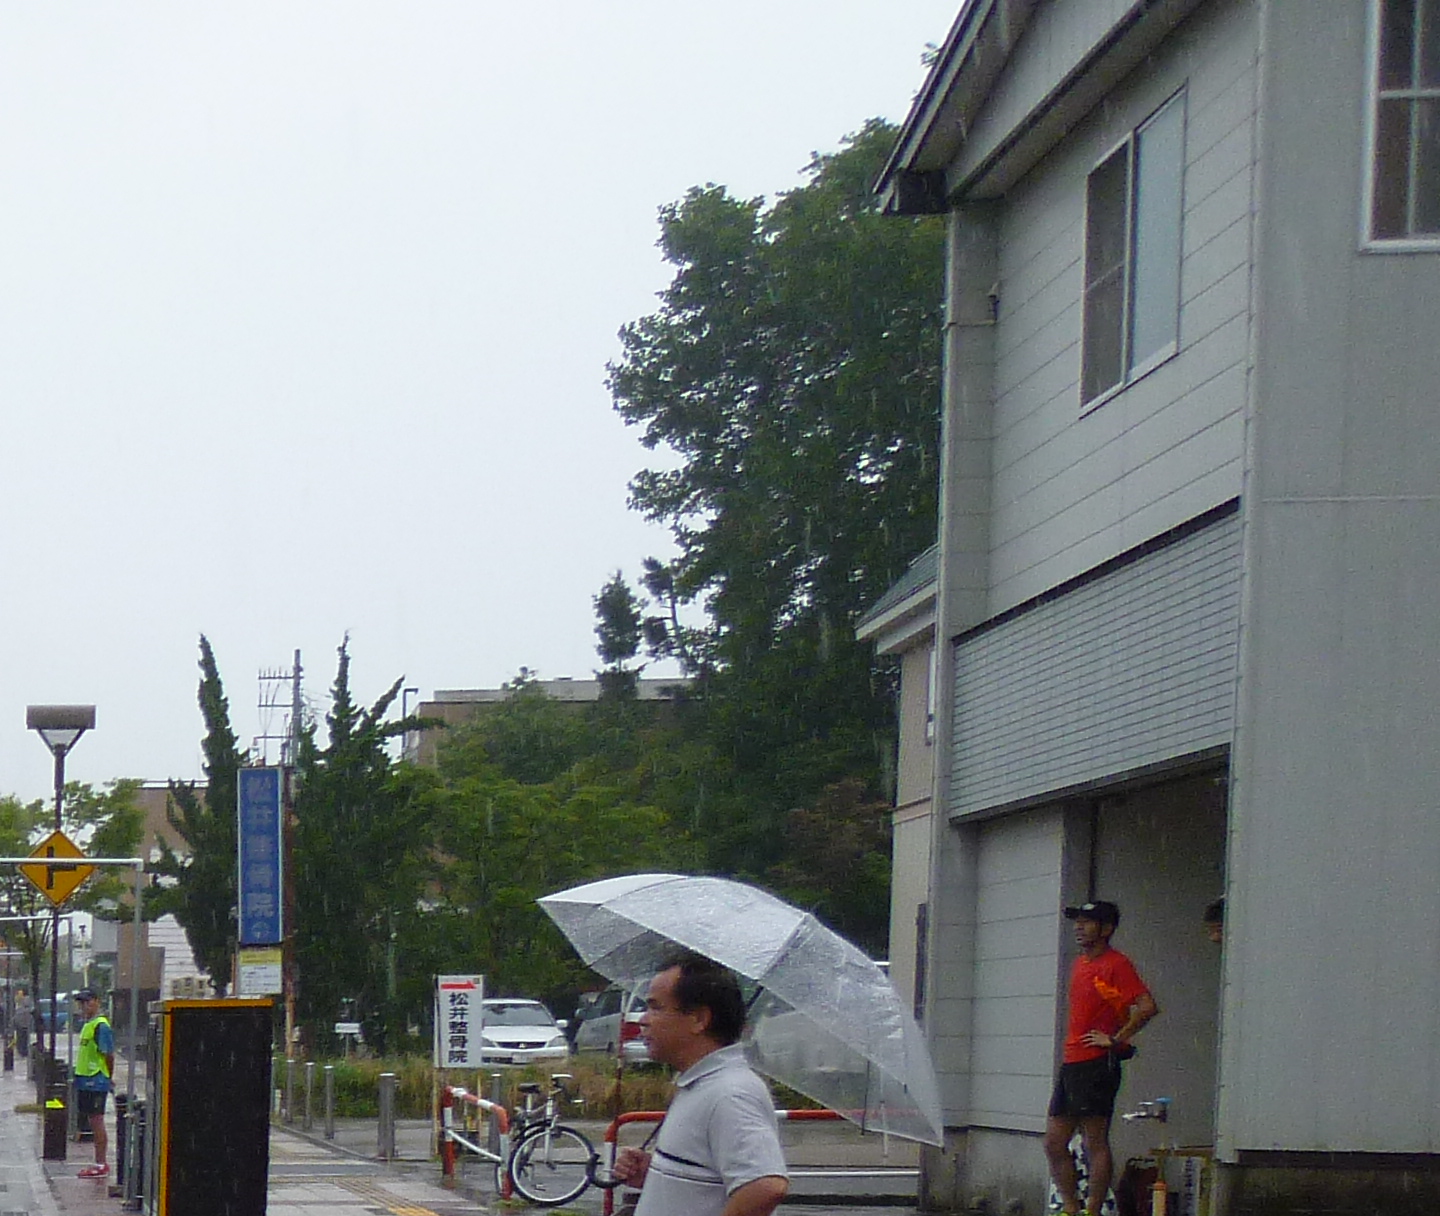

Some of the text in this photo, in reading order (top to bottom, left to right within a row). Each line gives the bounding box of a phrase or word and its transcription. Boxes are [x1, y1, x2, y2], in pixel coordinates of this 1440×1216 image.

[448, 992, 469, 1063] 松井整骨院
